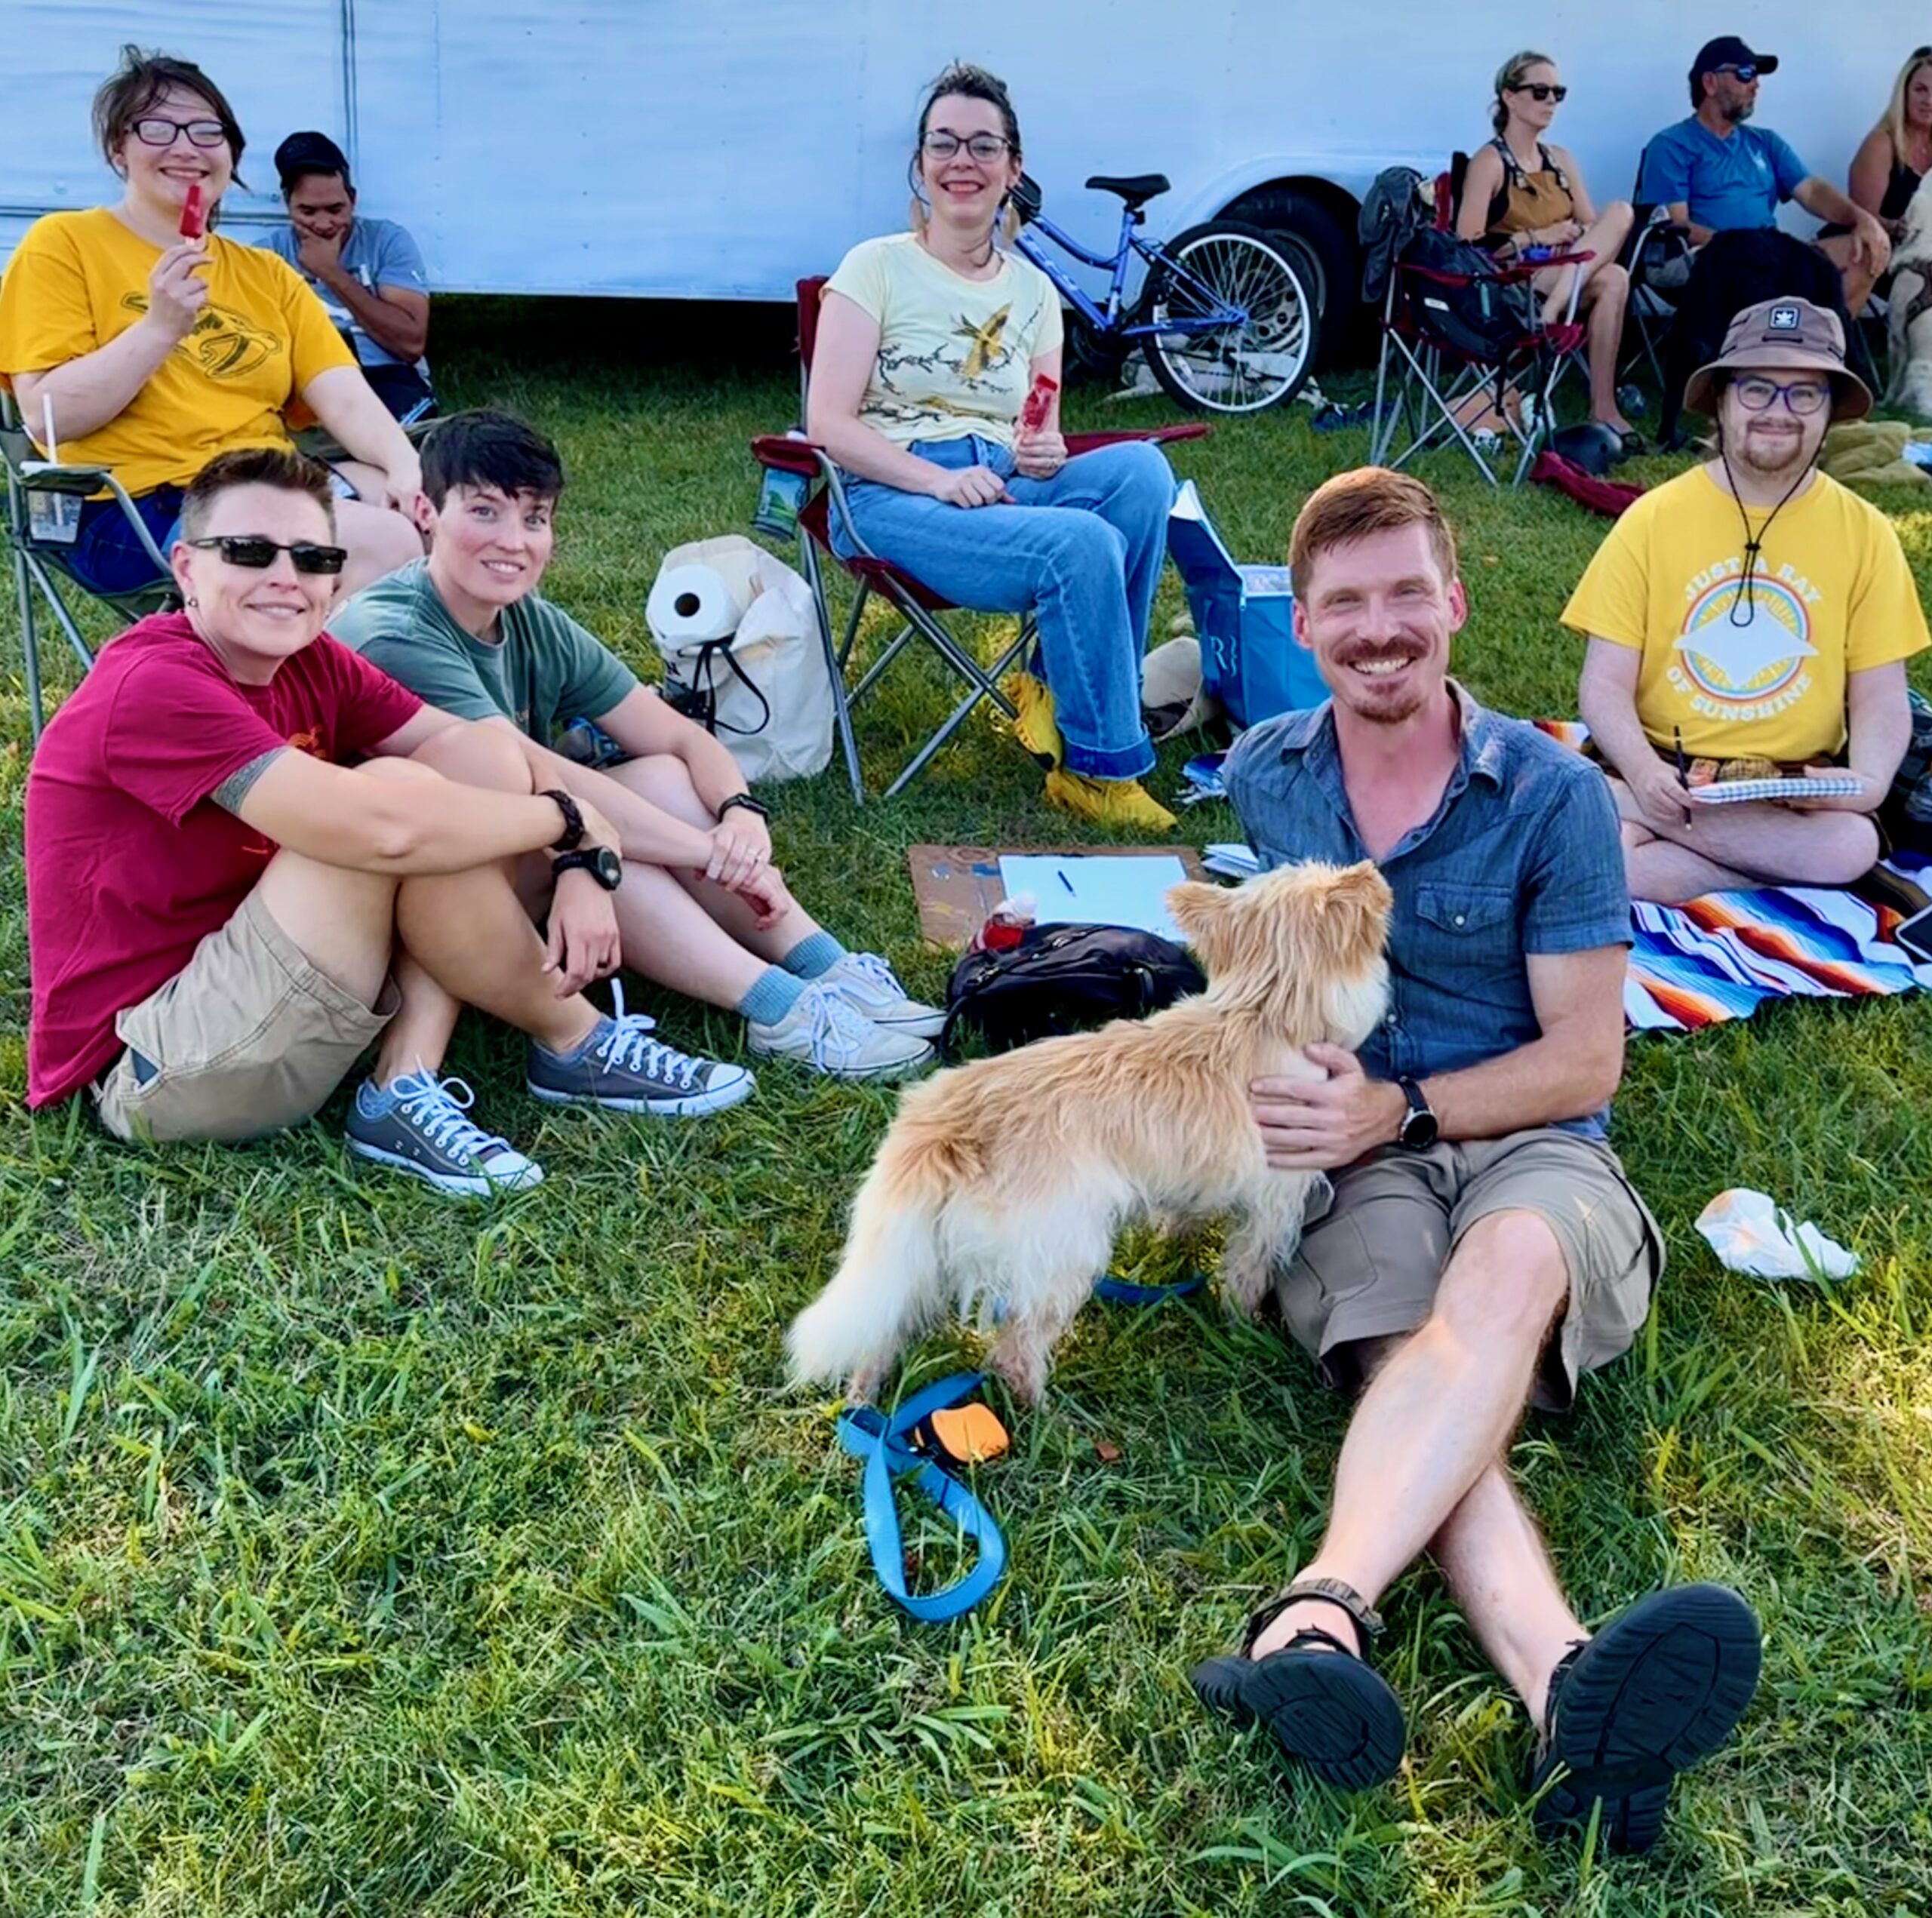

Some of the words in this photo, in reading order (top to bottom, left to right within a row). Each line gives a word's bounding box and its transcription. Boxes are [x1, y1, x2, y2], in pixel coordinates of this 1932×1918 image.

[1685, 557, 1740, 601] JUST
[1755, 557, 1769, 573] A
[1777, 563, 1822, 603] RAY
[1666, 666, 1693, 693] OF
[1690, 675, 1812, 721] SUNSHINE
